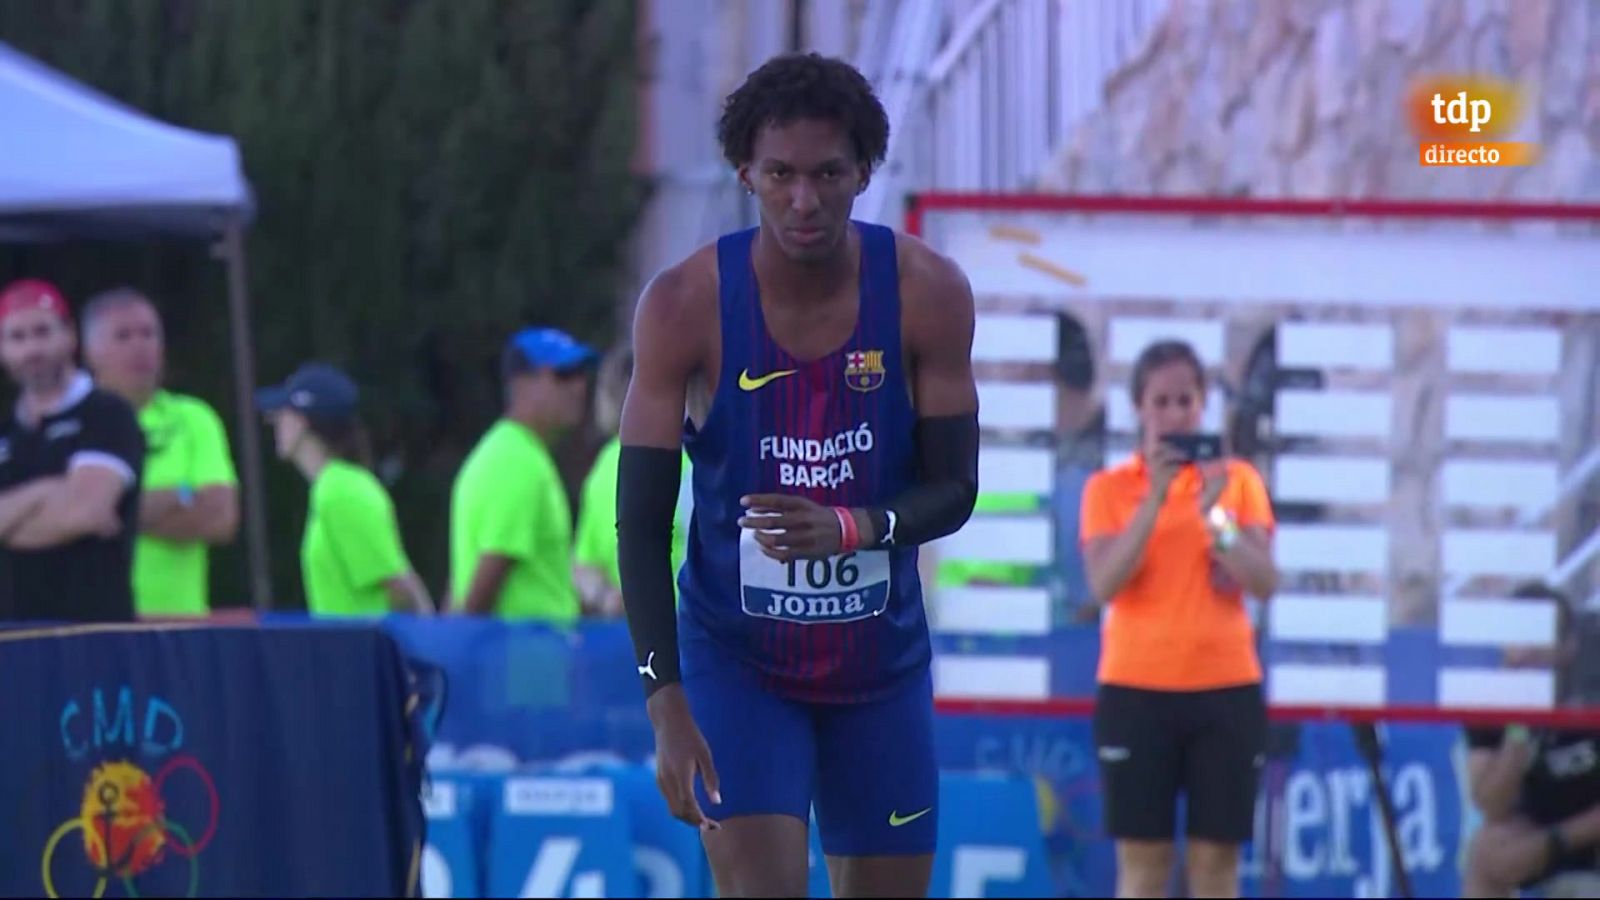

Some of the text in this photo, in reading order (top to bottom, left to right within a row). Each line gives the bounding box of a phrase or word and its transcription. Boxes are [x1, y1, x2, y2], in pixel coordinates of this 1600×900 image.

[760, 421, 874, 463] FUNDACIÓ
[779, 458, 855, 489] BARÇA
[786, 550, 860, 589] 106
[60, 686, 184, 760] CMD
